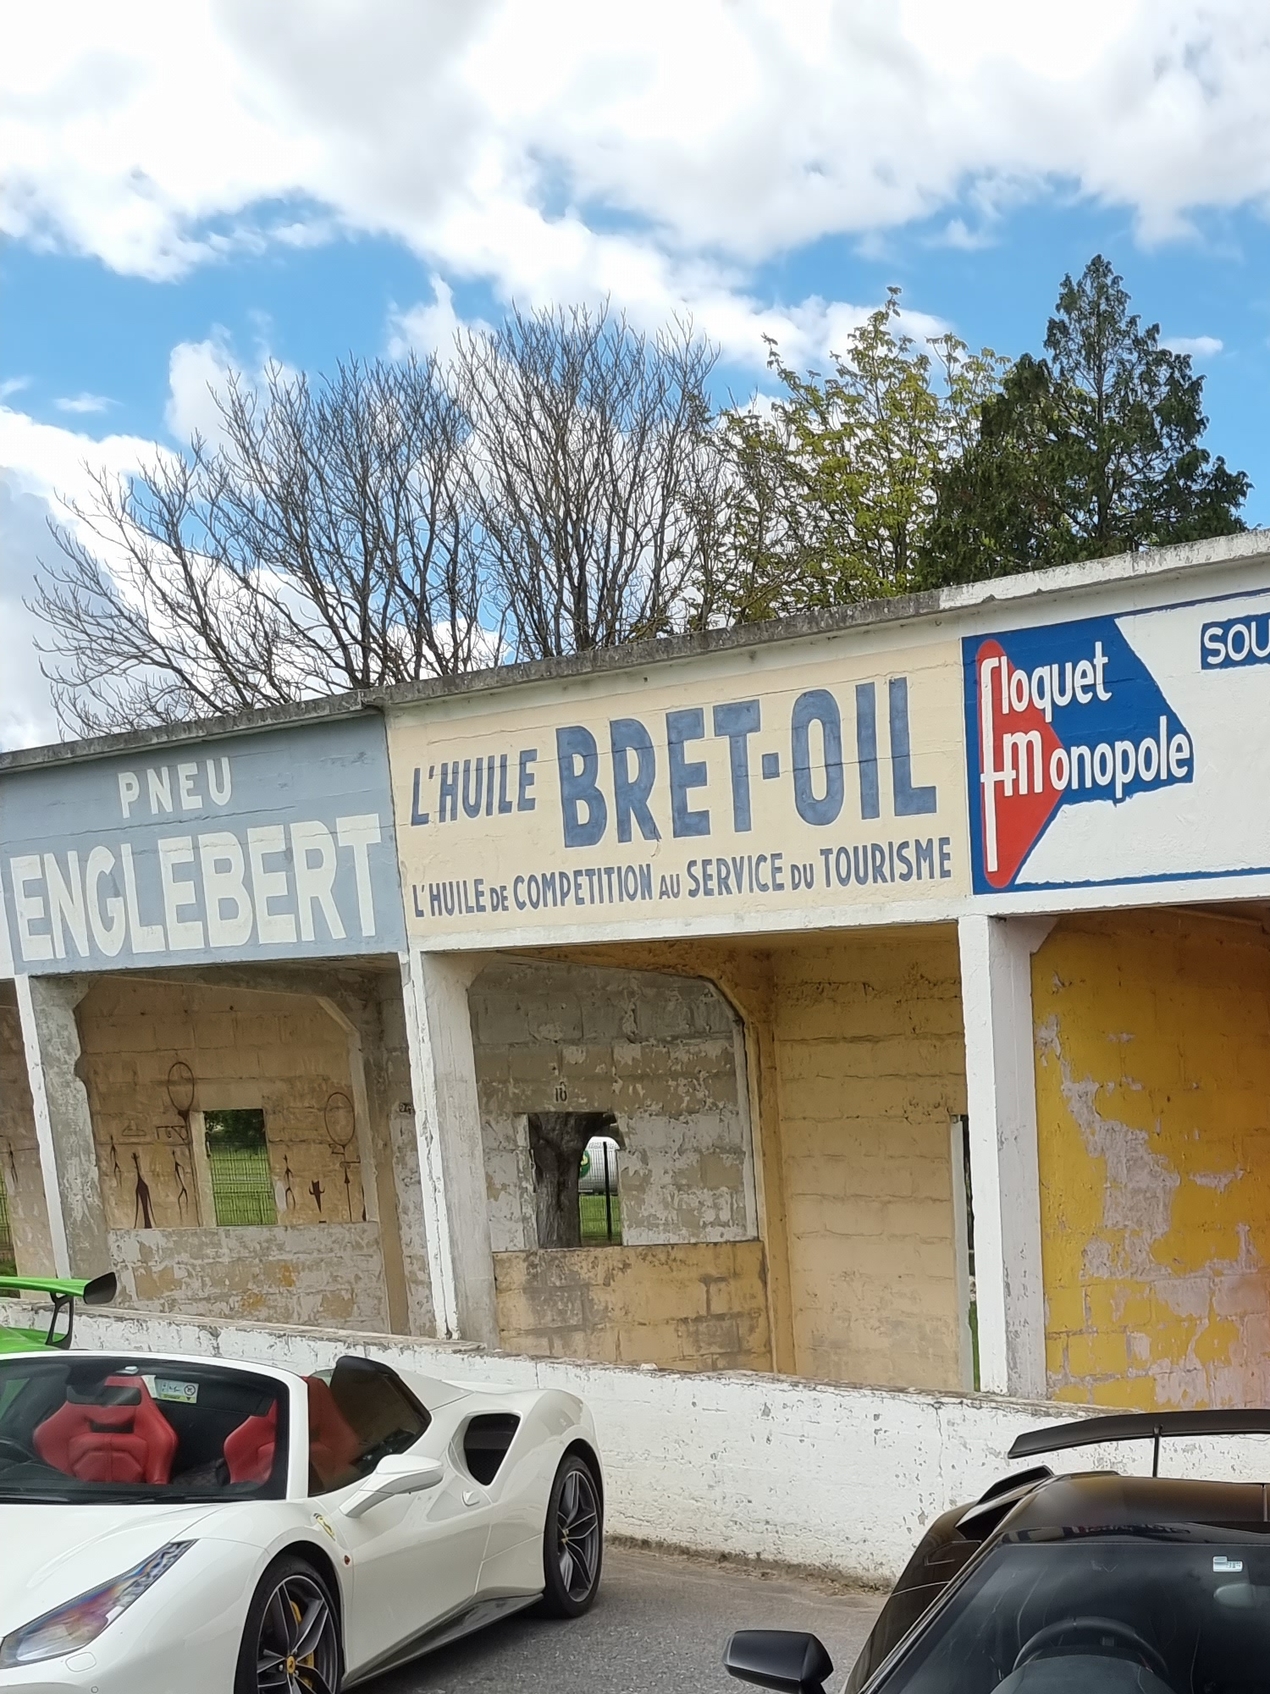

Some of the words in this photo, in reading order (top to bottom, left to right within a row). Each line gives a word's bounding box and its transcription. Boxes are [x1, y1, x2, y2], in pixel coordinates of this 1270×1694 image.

[117, 757, 233, 819] PNEU
[410, 748, 539, 827] L'HUILE
[555, 676, 938, 848] BRET-OIL
[10, 813, 381, 962] ENGLEBERT
[411, 880, 487, 918] L'HUILE
[489, 885, 510, 911] DE
[513, 863, 653, 910] COMPETITION
[658, 872, 682, 899] AU
[687, 852, 784, 898] SERVICE
[791, 863, 815, 889] DU
[820, 837, 953, 888] TOURISME
